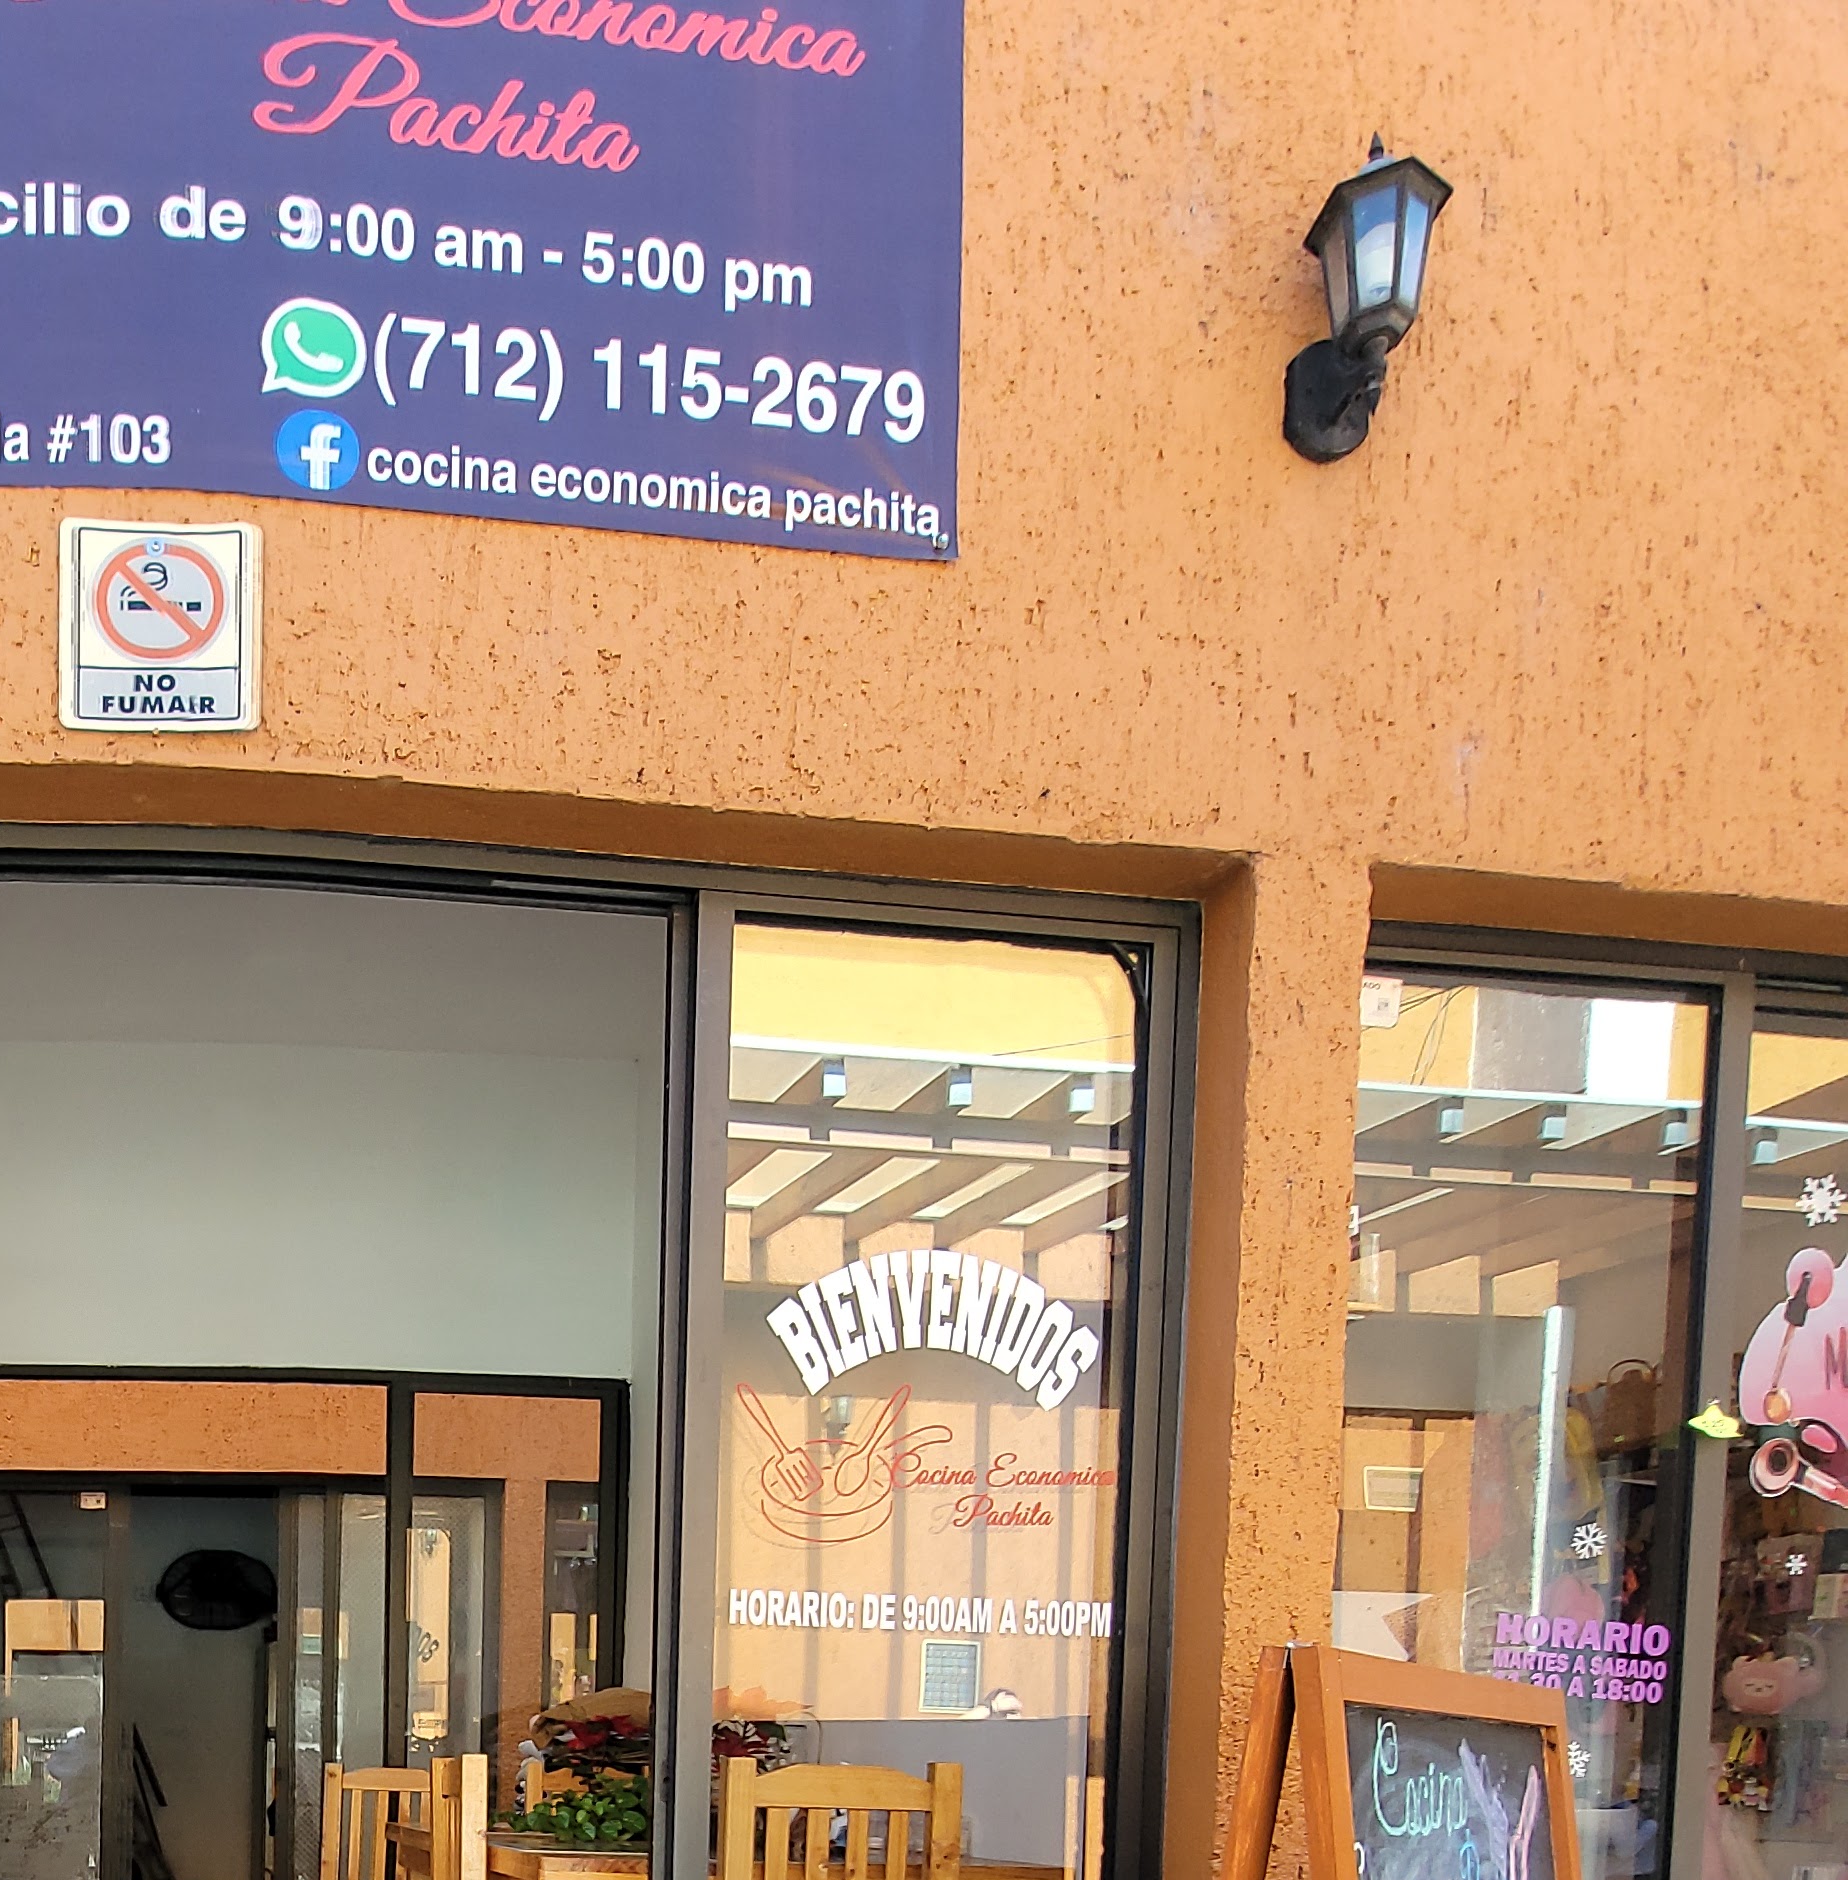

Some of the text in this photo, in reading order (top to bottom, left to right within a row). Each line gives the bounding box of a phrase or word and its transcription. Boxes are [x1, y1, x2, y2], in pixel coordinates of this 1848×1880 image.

[252, 32, 641, 173] Pachita
[158, 187, 247, 242] de
[277, 195, 415, 262] 9:00
[434, 222, 523, 275] am
[582, 232, 705, 296] 5:00
[724, 255, 813, 312] pm
[373, 313, 926, 445] (712) 115-2679
[47, 414, 171, 467] #103
[366, 443, 519, 496] cocina
[529, 458, 772, 520] economica
[133, 674, 176, 693] NO
[766, 1249, 1100, 1412] BIENVENIDOS
[892, 1452, 977, 1489] Cocina
[953, 1494, 1054, 1528] Pachita
[729, 1588, 1112, 1638] HORARIO: DE 9:00AM A 5:00PM
[1496, 1612, 1671, 1657] HORARIO
[1493, 1648, 1569, 1673] MARTES
[1572, 1655, 1586, 1674] A
[1590, 1655, 1667, 1681] SABADO
[1567, 1676, 1584, 1698] A
[1592, 1678, 1664, 1704] 18:00
[1372, 1716, 1471, 1837] Cocina
